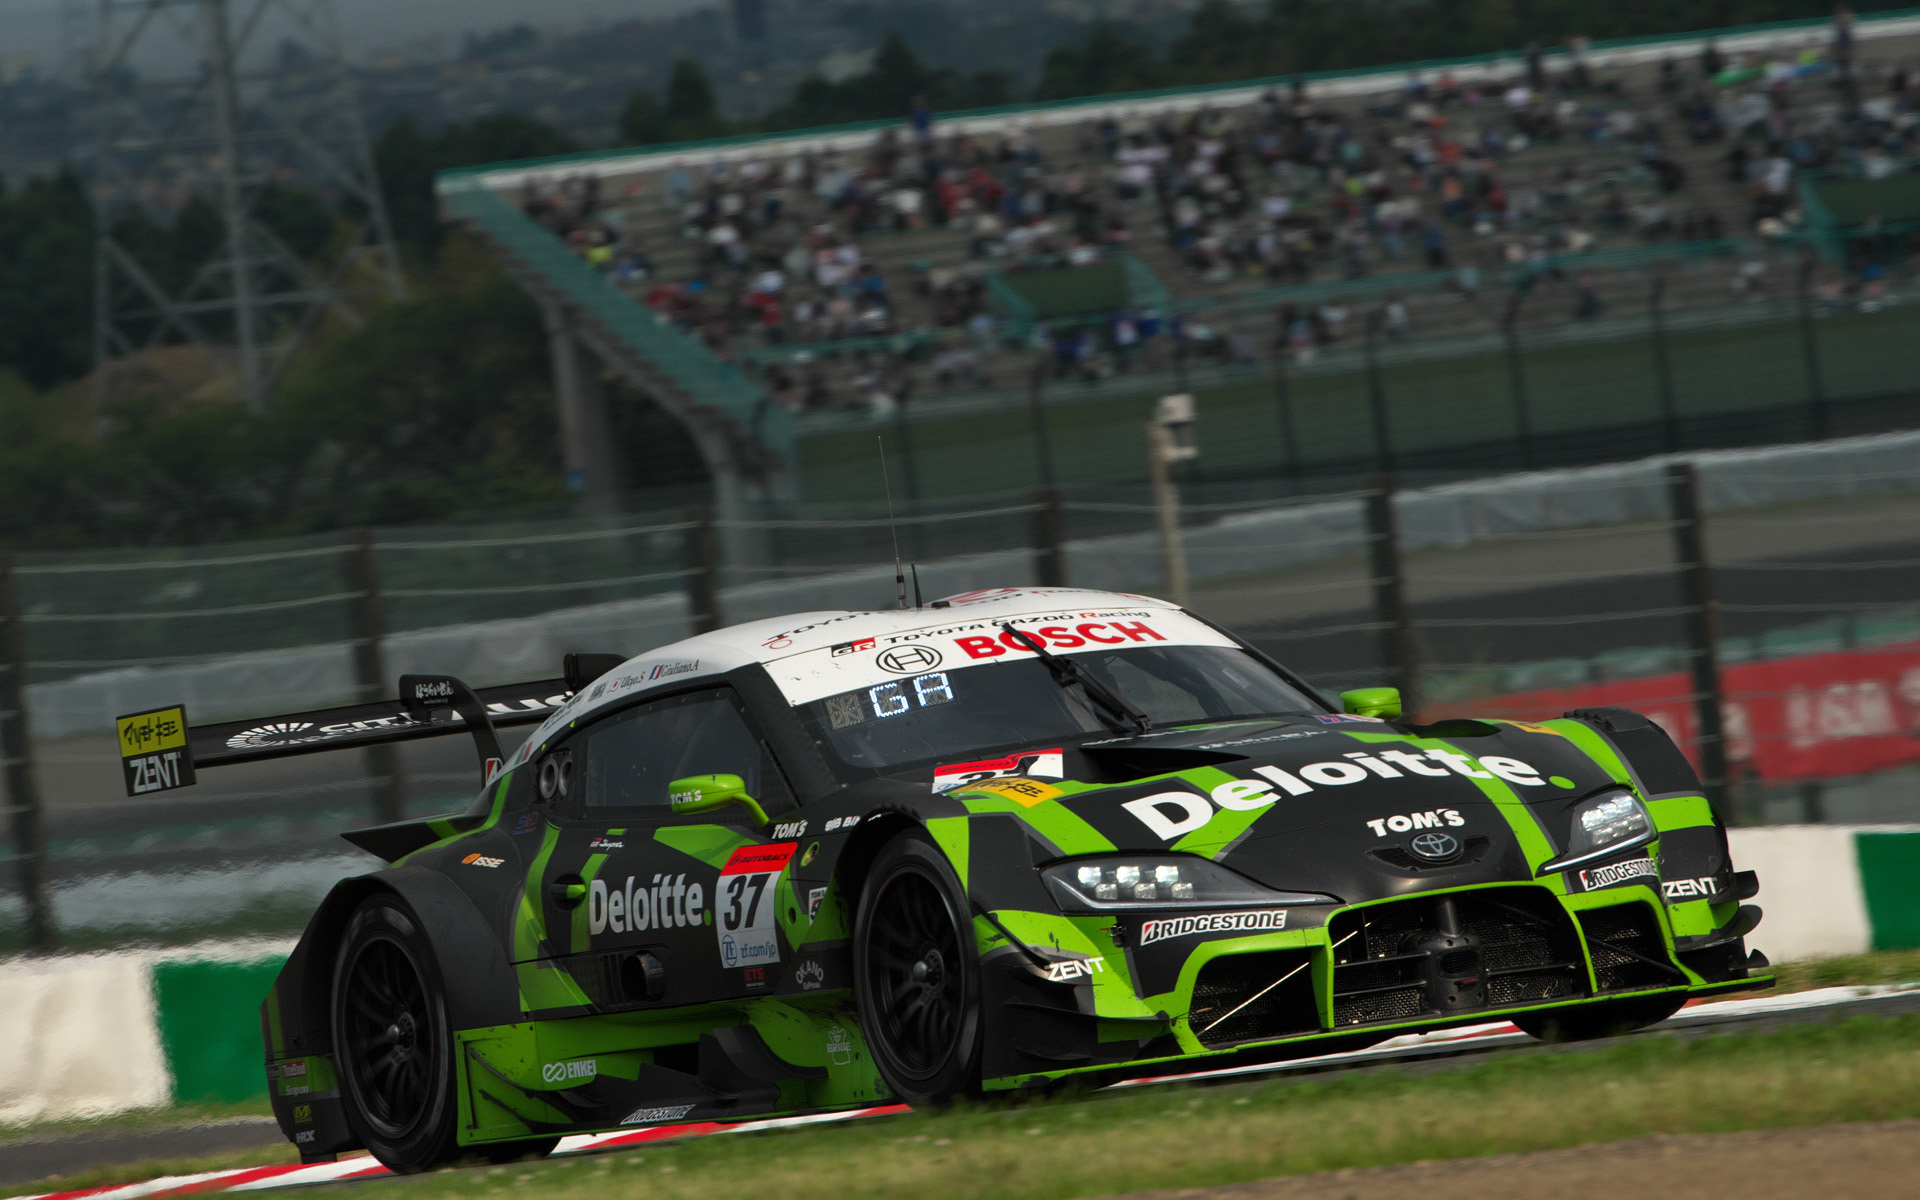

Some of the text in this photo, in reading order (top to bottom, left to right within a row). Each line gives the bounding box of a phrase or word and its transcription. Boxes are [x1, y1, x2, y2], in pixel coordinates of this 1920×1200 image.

[884, 611, 1151, 643] TOYOTA GAZOO Racing
[953, 621, 1168, 659] BOSCH
[868, 672, 953, 718] GA
[129, 751, 181, 793] ZENT
[771, 819, 808, 840] TOM'S
[1366, 808, 1465, 837] TOM'S
[741, 853, 790, 864] AUTOBACS
[1579, 857, 1660, 892] BRIDGESTONE
[1661, 877, 1718, 898] ZENT
[726, 873, 772, 931] 37
[1140, 910, 1288, 946] BRIDGESTONE
[740, 941, 776, 959] zf.com/jp
[796, 960, 824, 984] OKANO
[1047, 957, 1105, 982] ZENT
[567, 1060, 597, 1079] ENKEI
